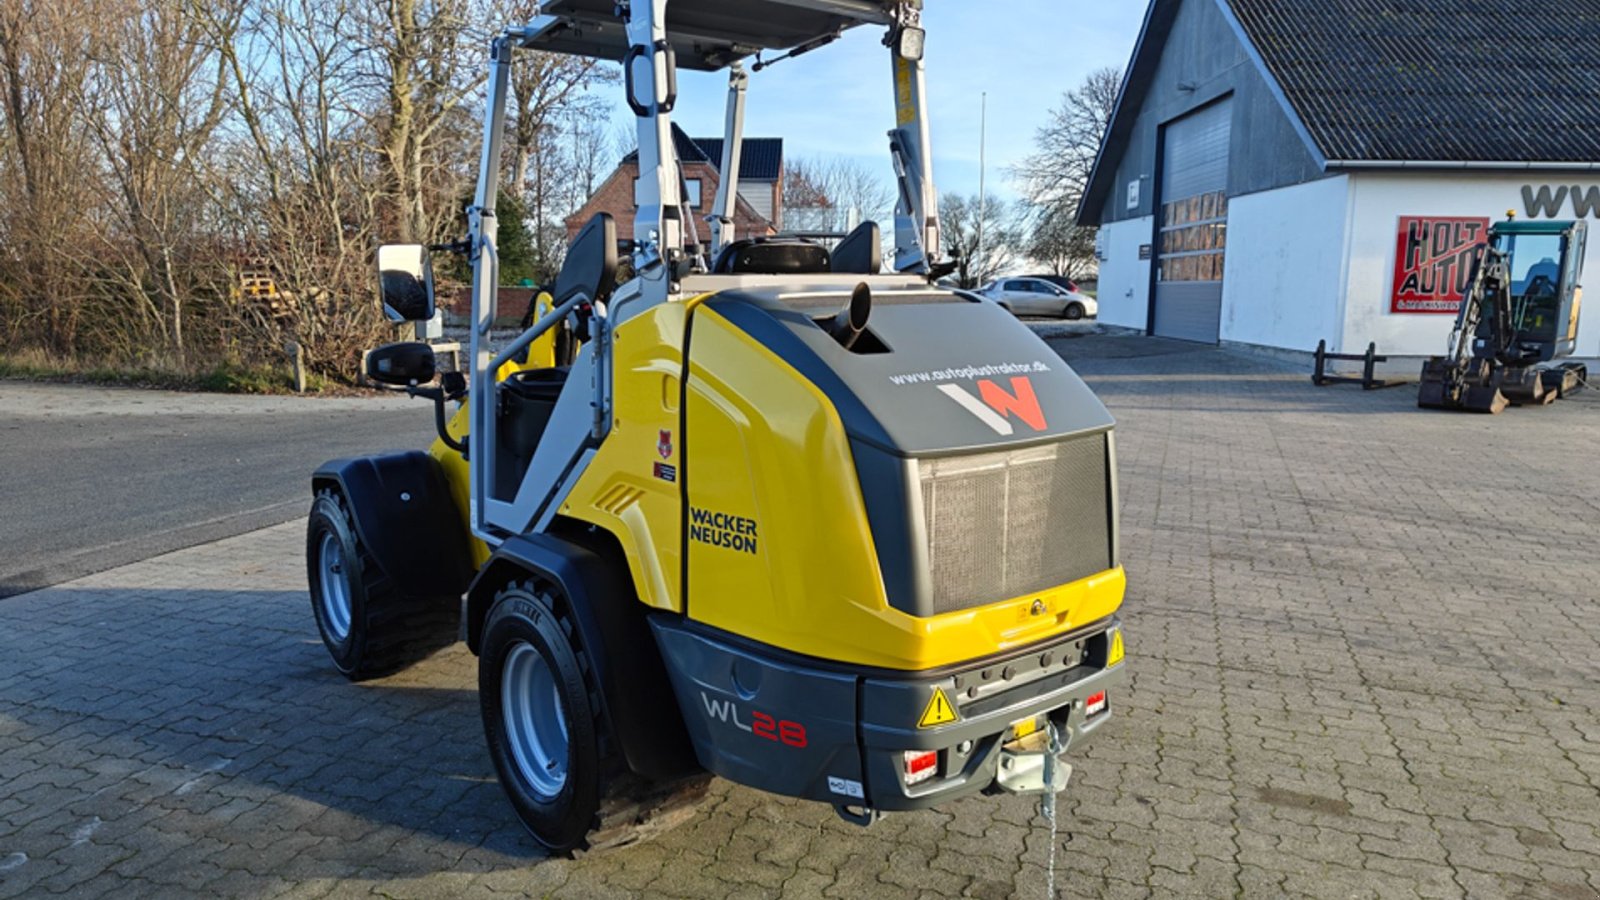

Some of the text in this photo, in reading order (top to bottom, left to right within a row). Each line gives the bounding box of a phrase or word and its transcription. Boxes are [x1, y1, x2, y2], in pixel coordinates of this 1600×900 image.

[1405, 221, 1482, 271] HOLT
[889, 361, 1051, 385] www.autoplustraktor.dk
[690, 506, 758, 537] WACKER
[690, 524, 757, 555] NEUSON
[701, 691, 808, 748] WL28
